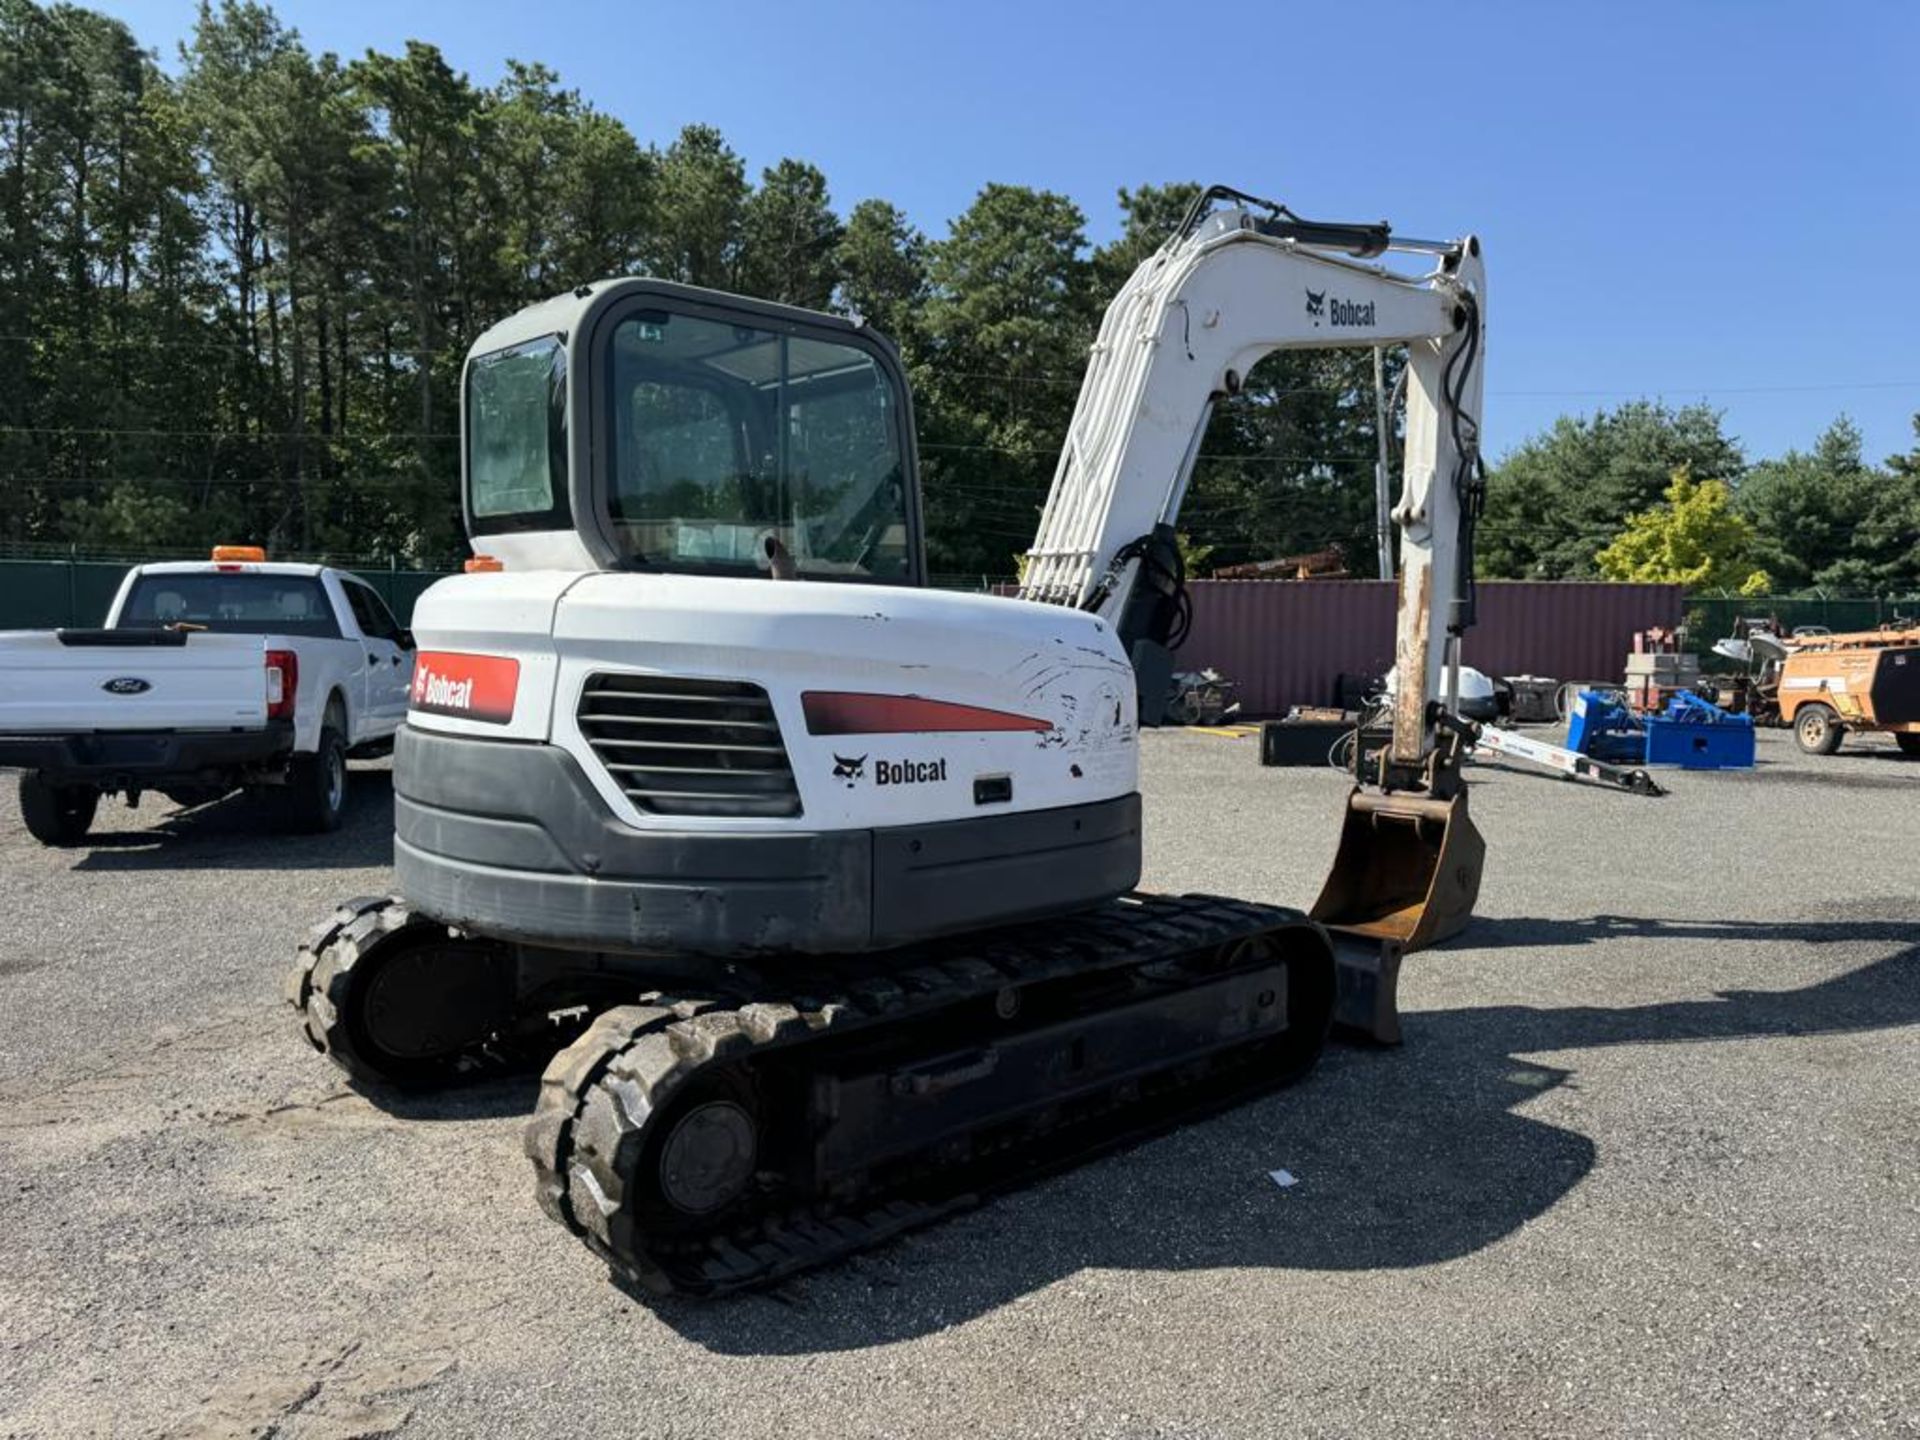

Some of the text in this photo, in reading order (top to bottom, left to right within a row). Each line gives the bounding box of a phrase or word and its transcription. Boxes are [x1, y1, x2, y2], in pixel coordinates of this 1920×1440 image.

[1330, 298, 1375, 327] Bobcat
[111, 679, 142, 691] Ford
[425, 671, 473, 709] Bobcat
[875, 757, 947, 786] Bobcat
